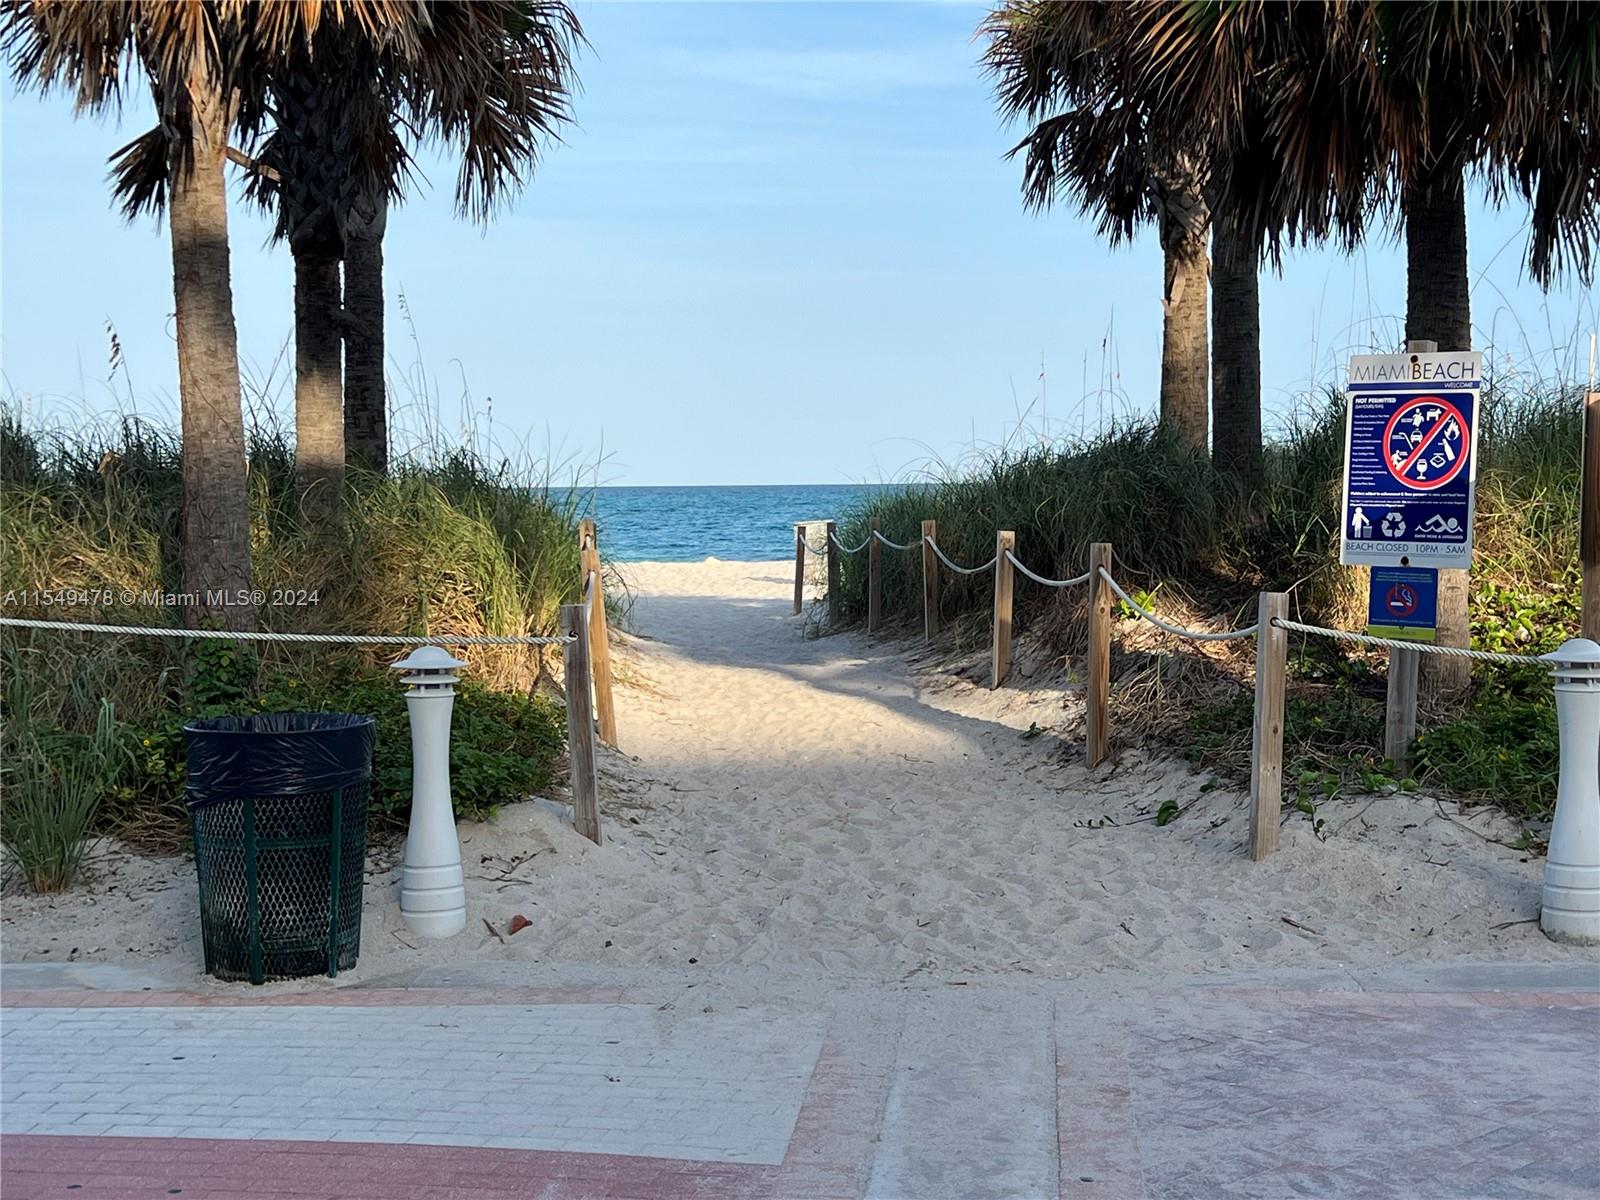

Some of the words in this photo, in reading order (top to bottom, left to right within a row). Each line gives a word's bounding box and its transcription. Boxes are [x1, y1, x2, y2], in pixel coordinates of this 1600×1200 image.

[1346, 542, 1374, 551] BEACH
[1376, 543, 1409, 552] CLOSED
[1416, 544, 1439, 553] 10PM
[1446, 545, 1466, 554] 5AM
